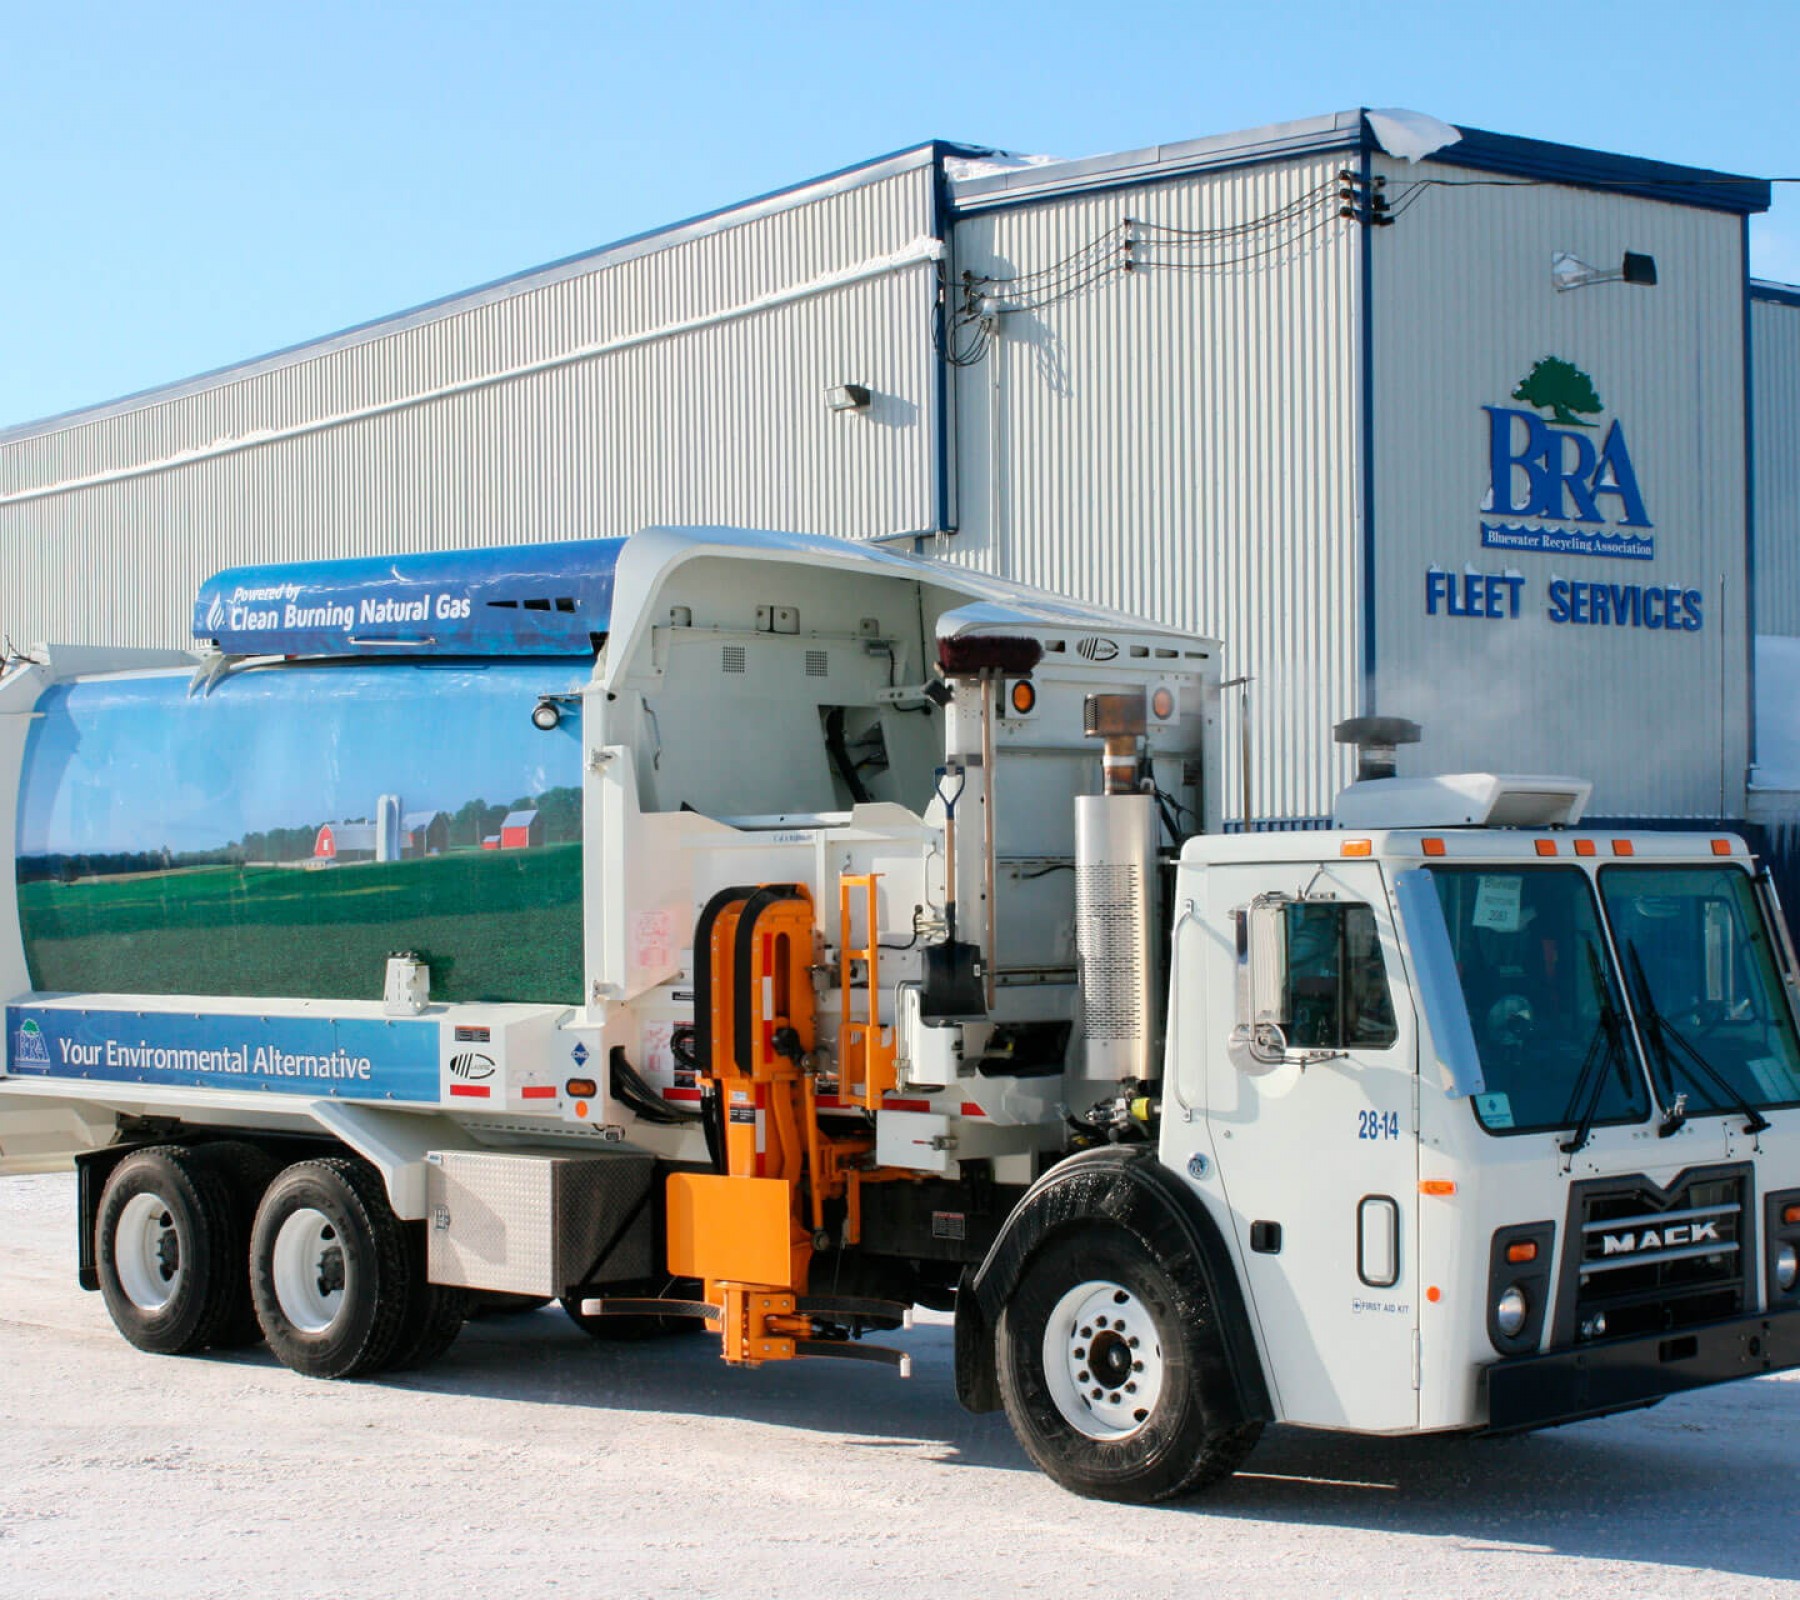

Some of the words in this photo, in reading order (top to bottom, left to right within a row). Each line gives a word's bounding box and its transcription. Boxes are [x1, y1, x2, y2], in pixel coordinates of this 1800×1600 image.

[1480, 405, 1654, 528] BRA
[1487, 530, 1540, 547] Bluewater
[1542, 534, 1593, 553] Recycling
[1593, 542, 1652, 555] Association
[233, 587, 282, 602] Powered
[284, 584, 301, 601] by
[1426, 571, 1525, 619] FLEET
[1548, 578, 1703, 632] SERVICES
[229, 608, 279, 631] Clean
[284, 601, 355, 631] Burning
[359, 595, 431, 624] Natural
[435, 594, 471, 619] Gas
[59, 1038, 103, 1066] Your
[106, 1040, 249, 1075] Environmental
[252, 1046, 371, 1080] Alternative
[1358, 1110, 1400, 1140] 28-14
[1603, 1221, 1719, 1255] MACK
[1361, 1302, 1380, 1311] FIRST
[1383, 1303, 1396, 1312] AID
